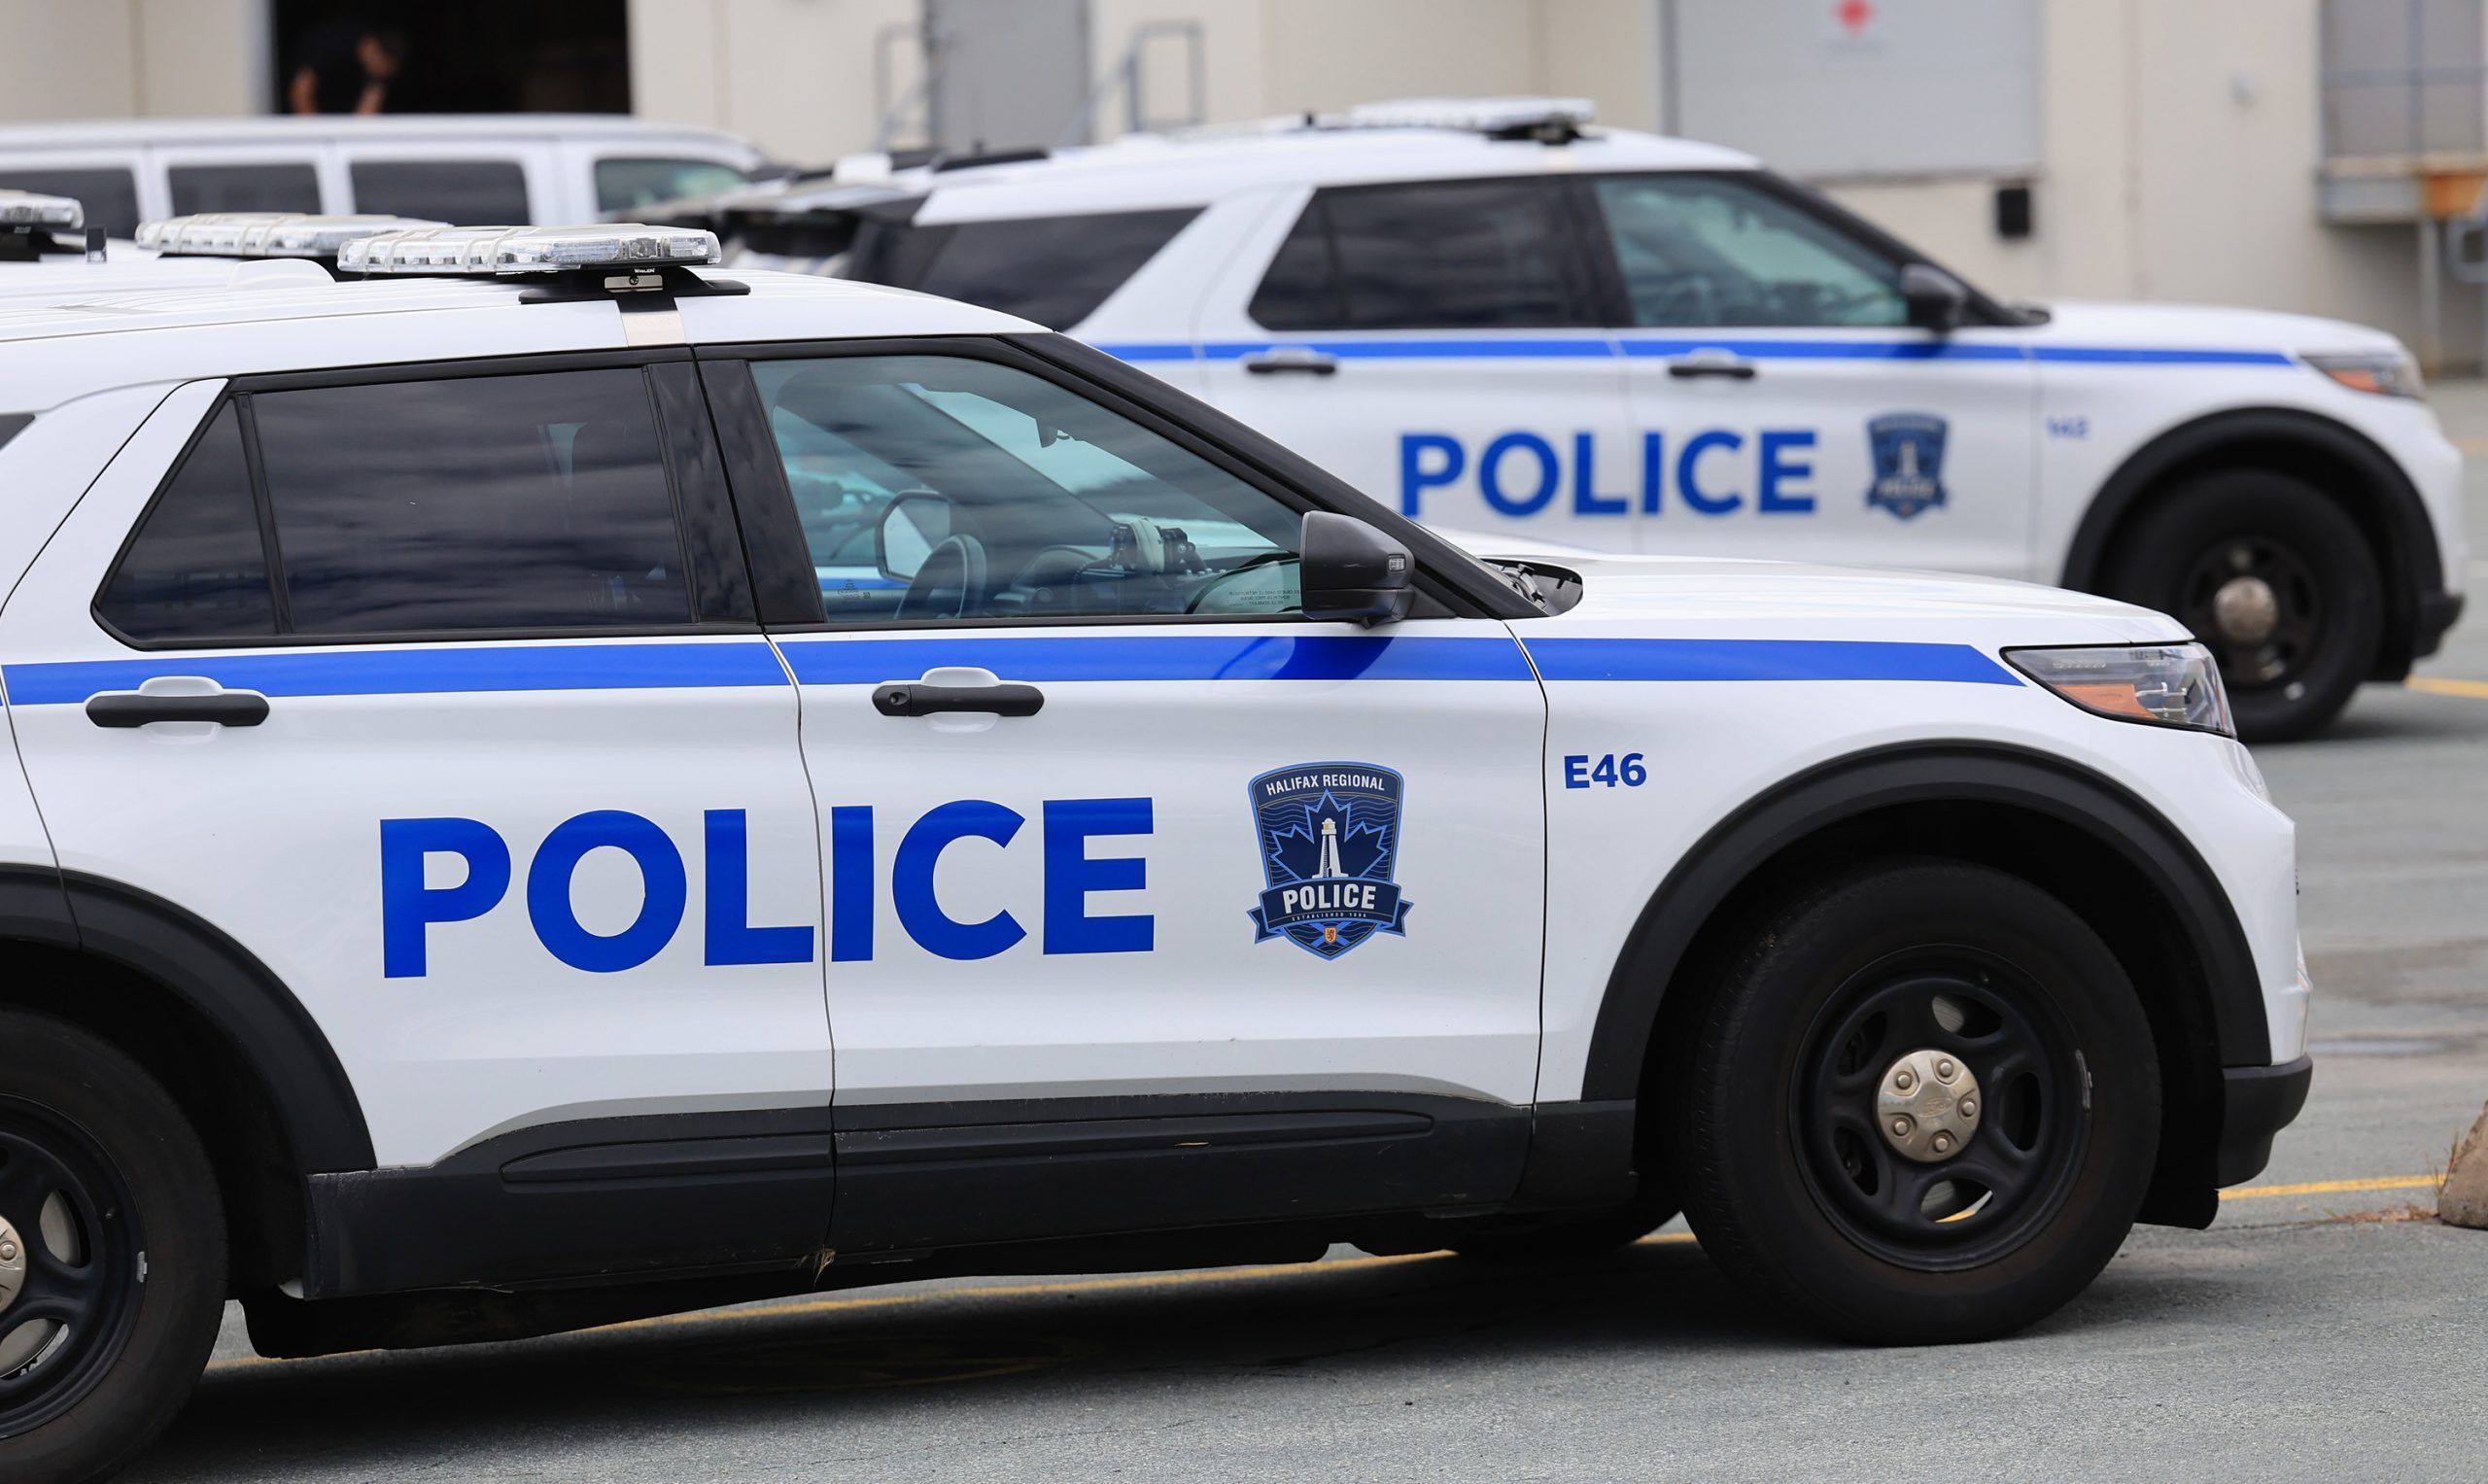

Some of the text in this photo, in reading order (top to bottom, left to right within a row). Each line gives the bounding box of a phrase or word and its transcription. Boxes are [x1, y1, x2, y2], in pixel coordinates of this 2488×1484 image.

[1399, 430, 1816, 518] POLICE
[1265, 774, 1385, 796] HALIFAX REGIONAL
[1564, 752, 1647, 789] E46
[379, 797, 1155, 979] POLICE
[1282, 883, 1377, 915] POLICE
